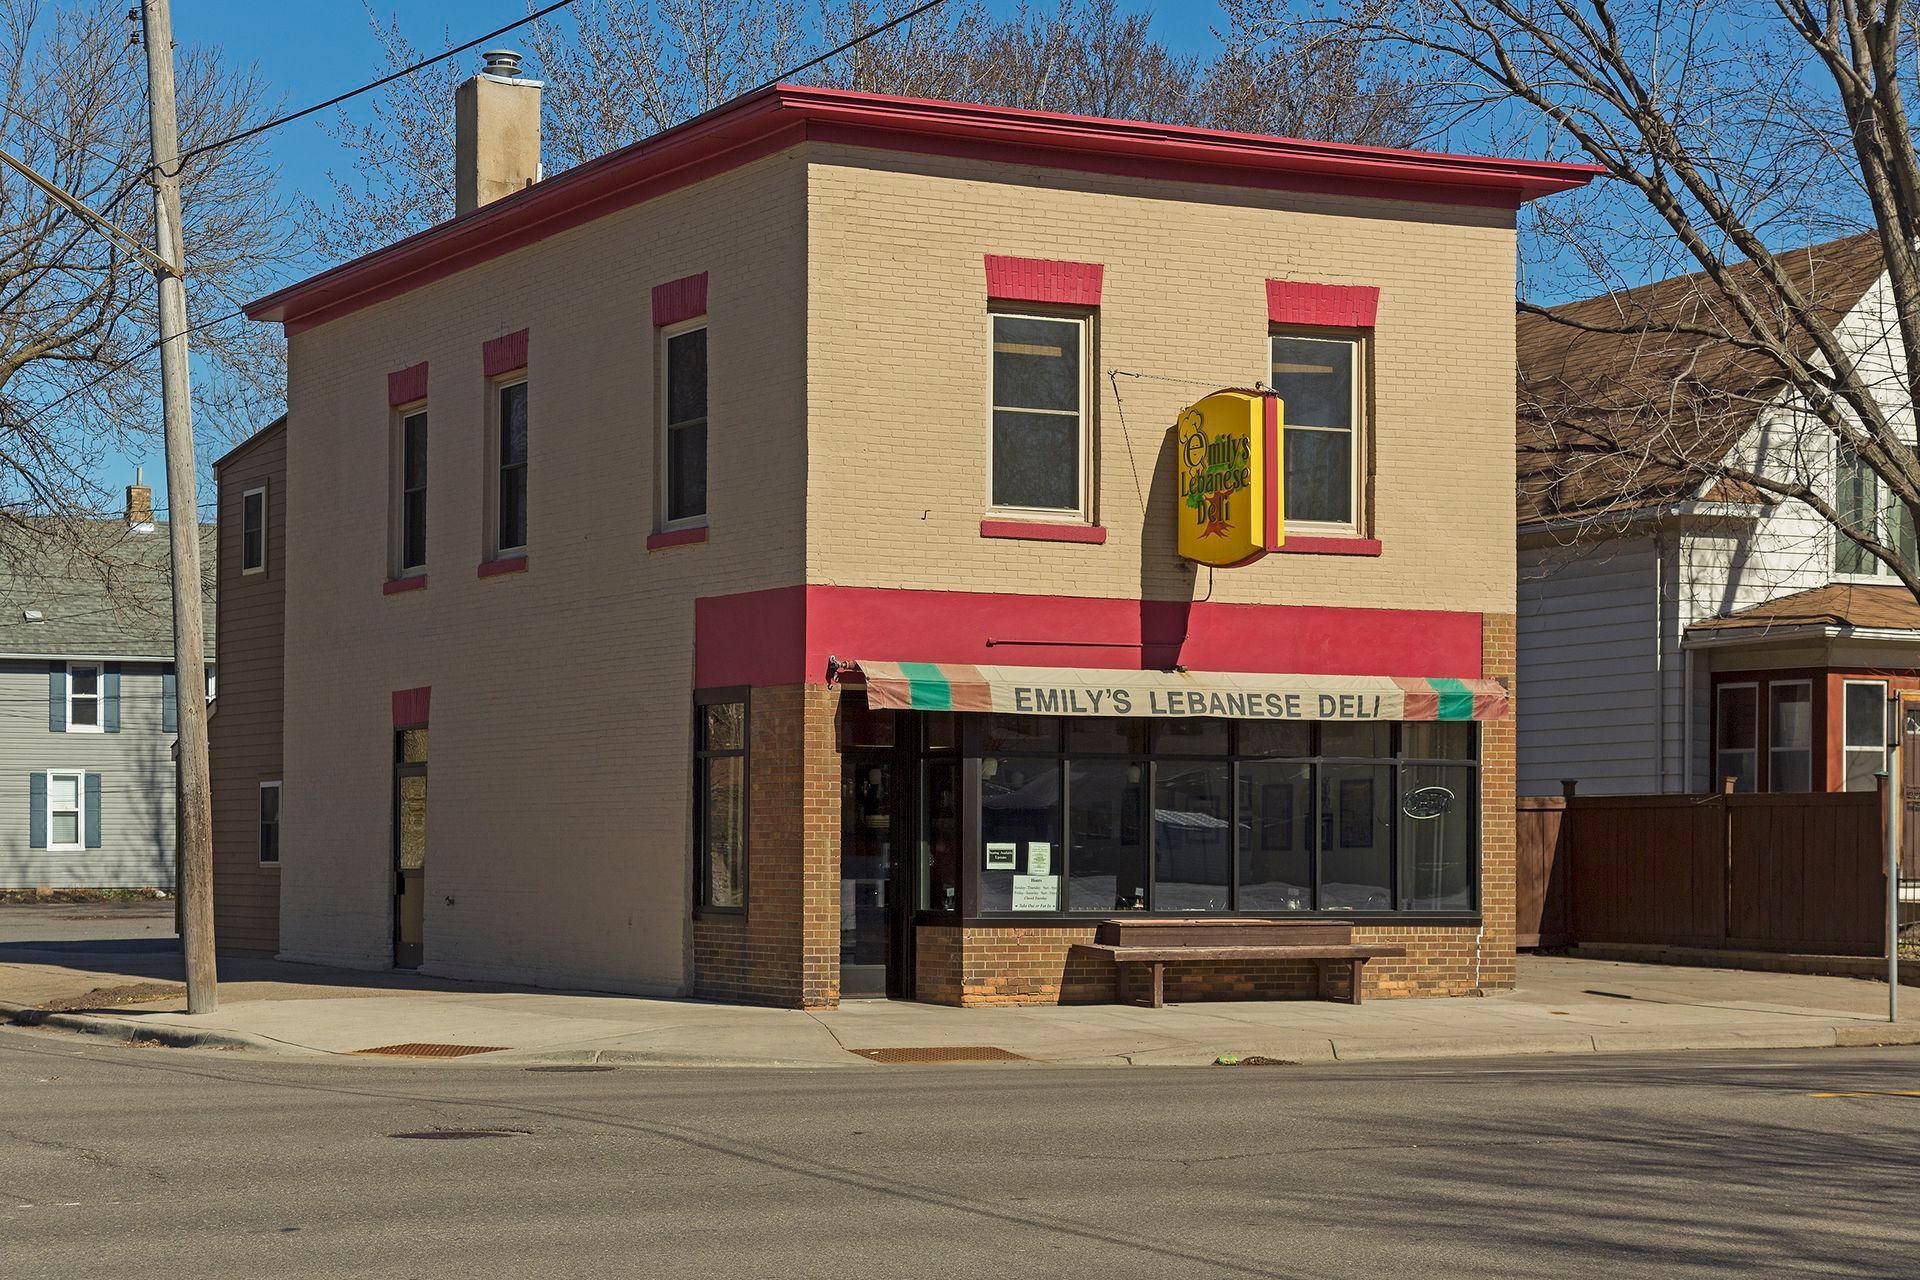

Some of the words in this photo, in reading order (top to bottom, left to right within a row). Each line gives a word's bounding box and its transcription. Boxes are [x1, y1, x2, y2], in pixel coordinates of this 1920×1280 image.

[1181, 467, 1250, 497] Lebanese
[1197, 494, 1229, 525] Deli
[1014, 687, 1132, 714] EMILY'S
[1150, 690, 1301, 718] LEBANESE
[1318, 693, 1380, 718] DELI
